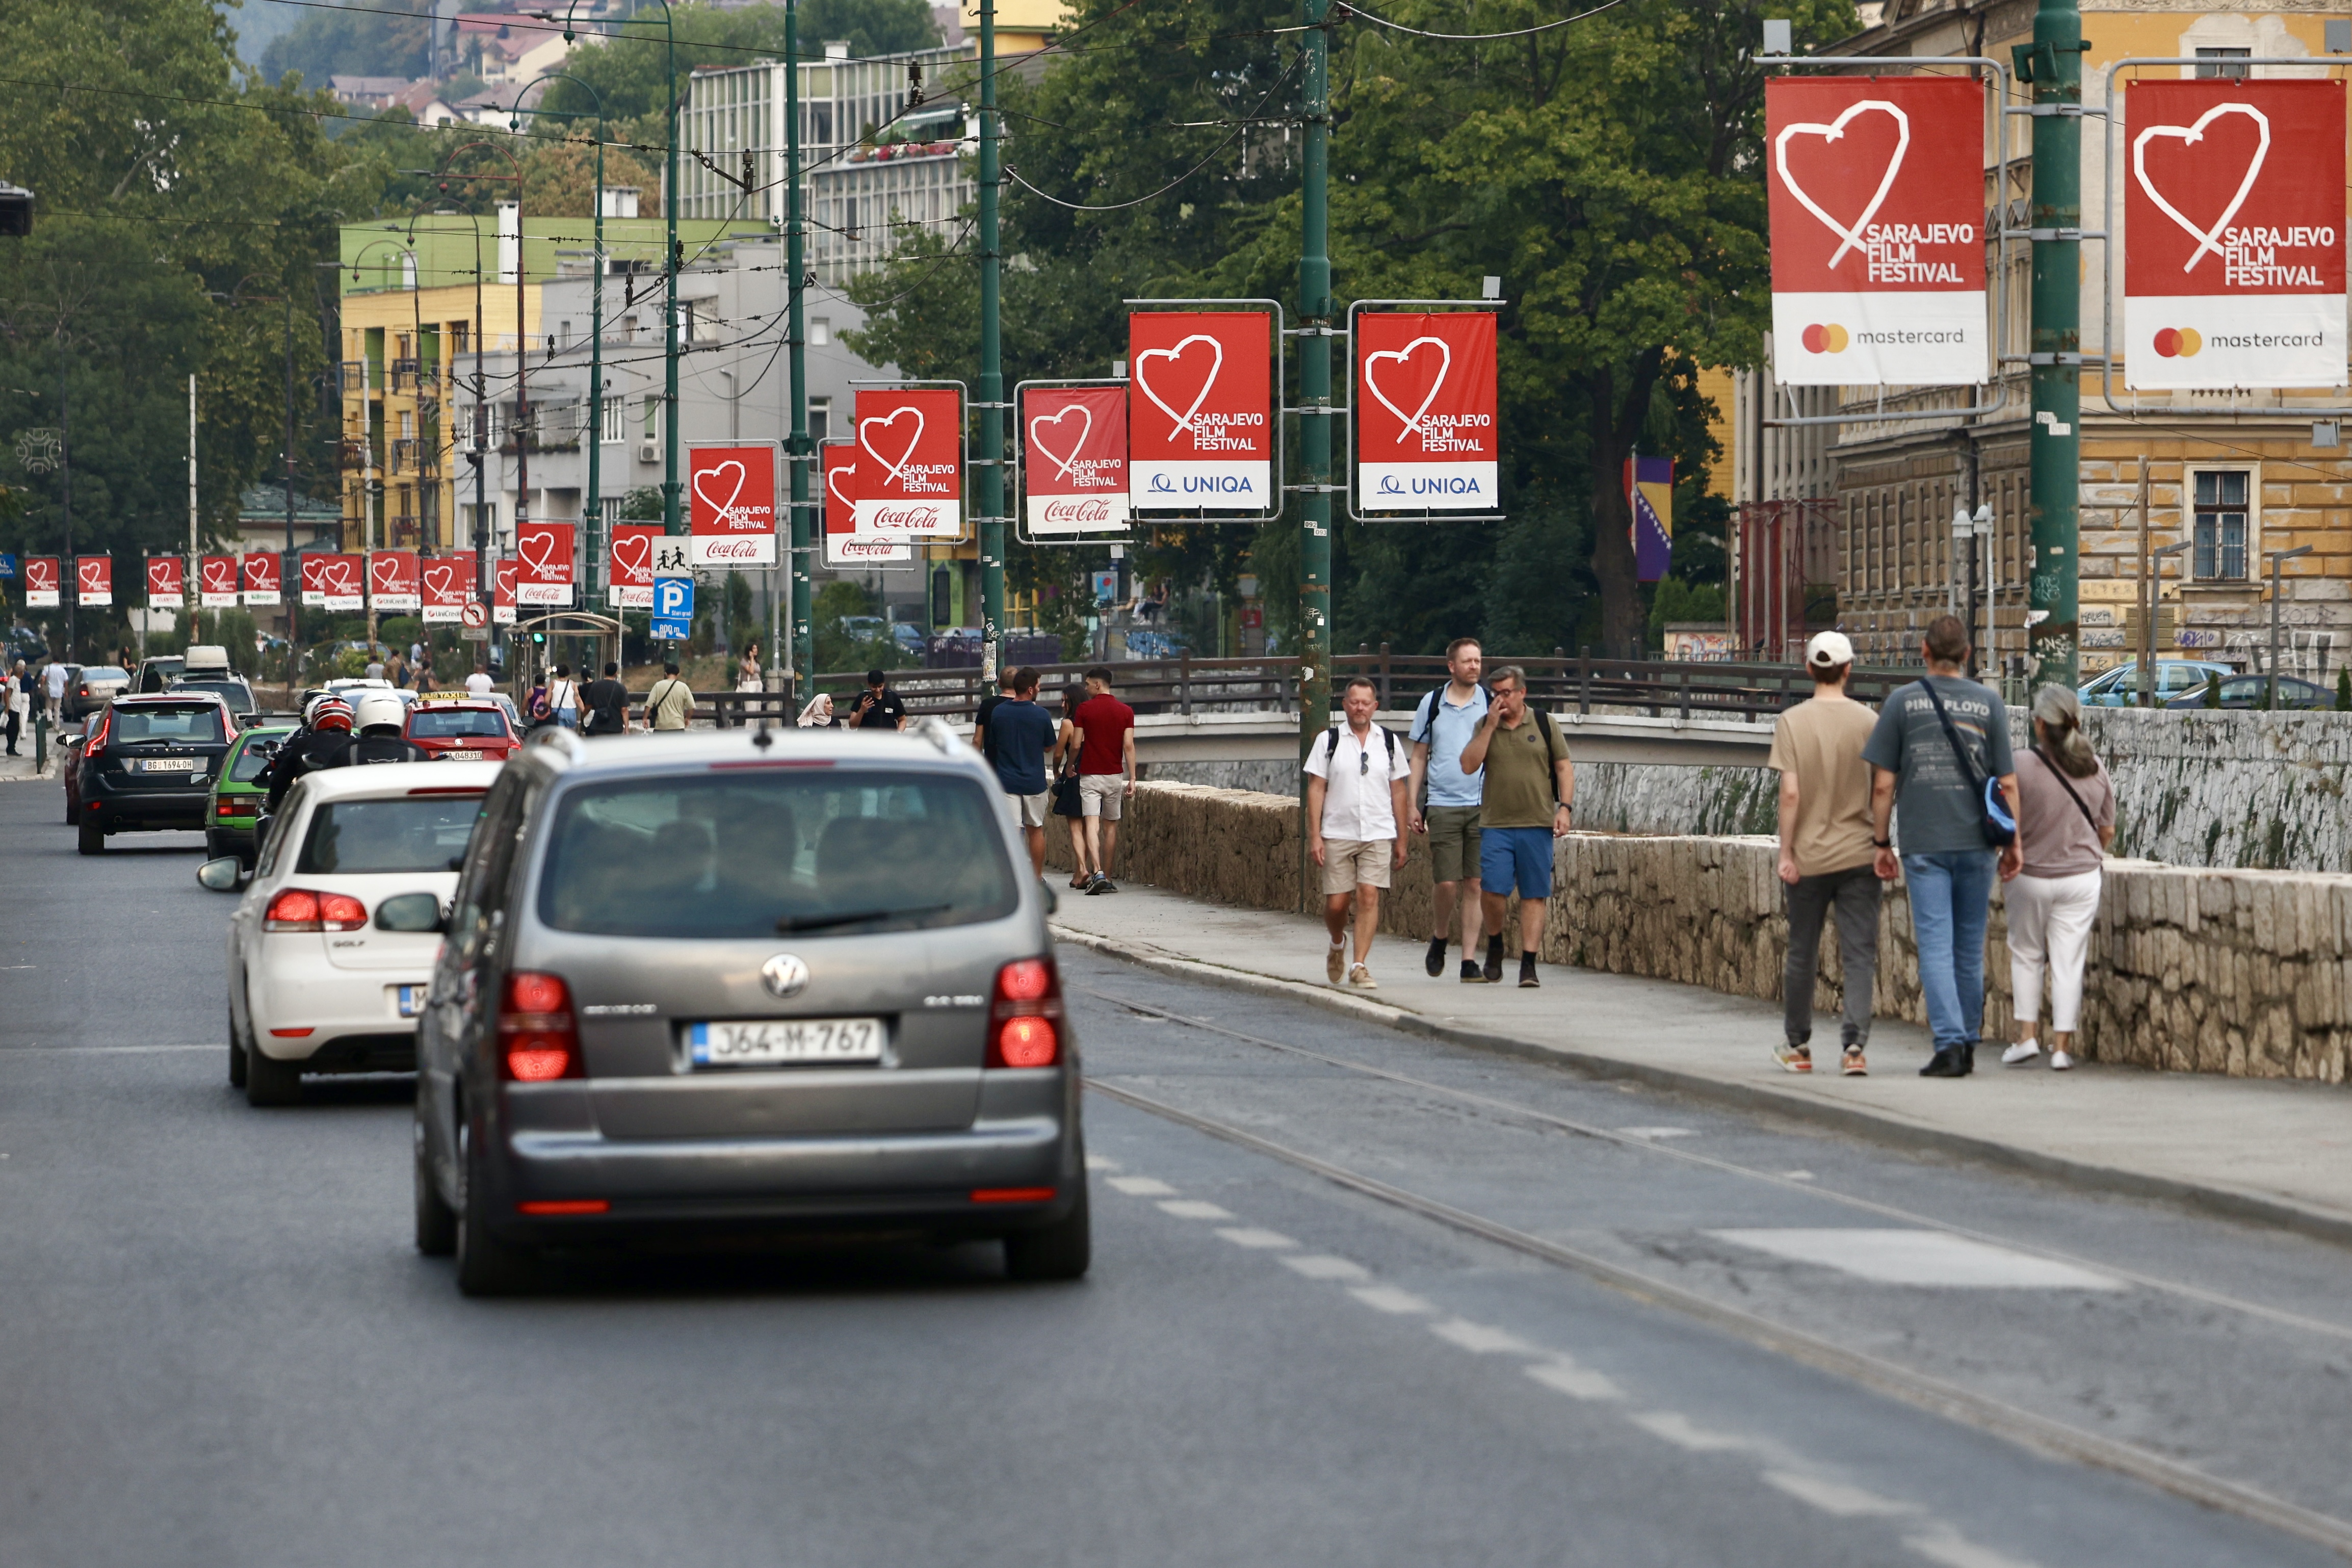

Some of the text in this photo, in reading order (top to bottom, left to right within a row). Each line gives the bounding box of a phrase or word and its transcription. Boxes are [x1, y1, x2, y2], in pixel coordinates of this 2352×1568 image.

[1866, 223, 1974, 244] SARAJEVO
[2224, 227, 2335, 247] SARAJEVO
[1867, 243, 1916, 263] FILM
[2225, 247, 2275, 267] FILM
[1868, 263, 1964, 283] FESTIVAL
[2225, 266, 2324, 286] FESTIVAL
[1857, 328, 1965, 344] mastercard
[2211, 332, 2323, 348] mastercard
[1193, 413, 1263, 426] SARAJEVO
[1421, 414, 1490, 427] SARAJEVO
[1194, 426, 1225, 438] FILM
[1422, 427, 1453, 439] FILM
[1194, 437, 1257, 450] FESTIVAL
[1422, 438, 1484, 452] FESTIVAL
[902, 464, 955, 474] SARAJEVO
[1072, 459, 1121, 469] SARAJEVO
[903, 474, 927, 483] FILM
[1073, 468, 1095, 478] FILM
[903, 483, 950, 492] FESTIVAL
[1073, 476, 1117, 487] FESTIVAL
[1184, 476, 1253, 493] UNIQA
[1412, 477, 1481, 494] UNIQA
[728, 506, 770, 514] SARAJEVO
[874, 506, 942, 528] Coca-Cola
[1044, 499, 1112, 522] Coca-Cola
[729, 521, 767, 530] FESTIVAL
[706, 540, 757, 558] Coca-Cola
[842, 537, 893, 556] CocaCola
[525, 587, 561, 600] Coca-Cola
[663, 586, 683, 614] P
[660, 624, 672, 633] 800
[1943, 699, 1990, 716] FLOYD
[718, 1025, 871, 1053] J64-M-767
